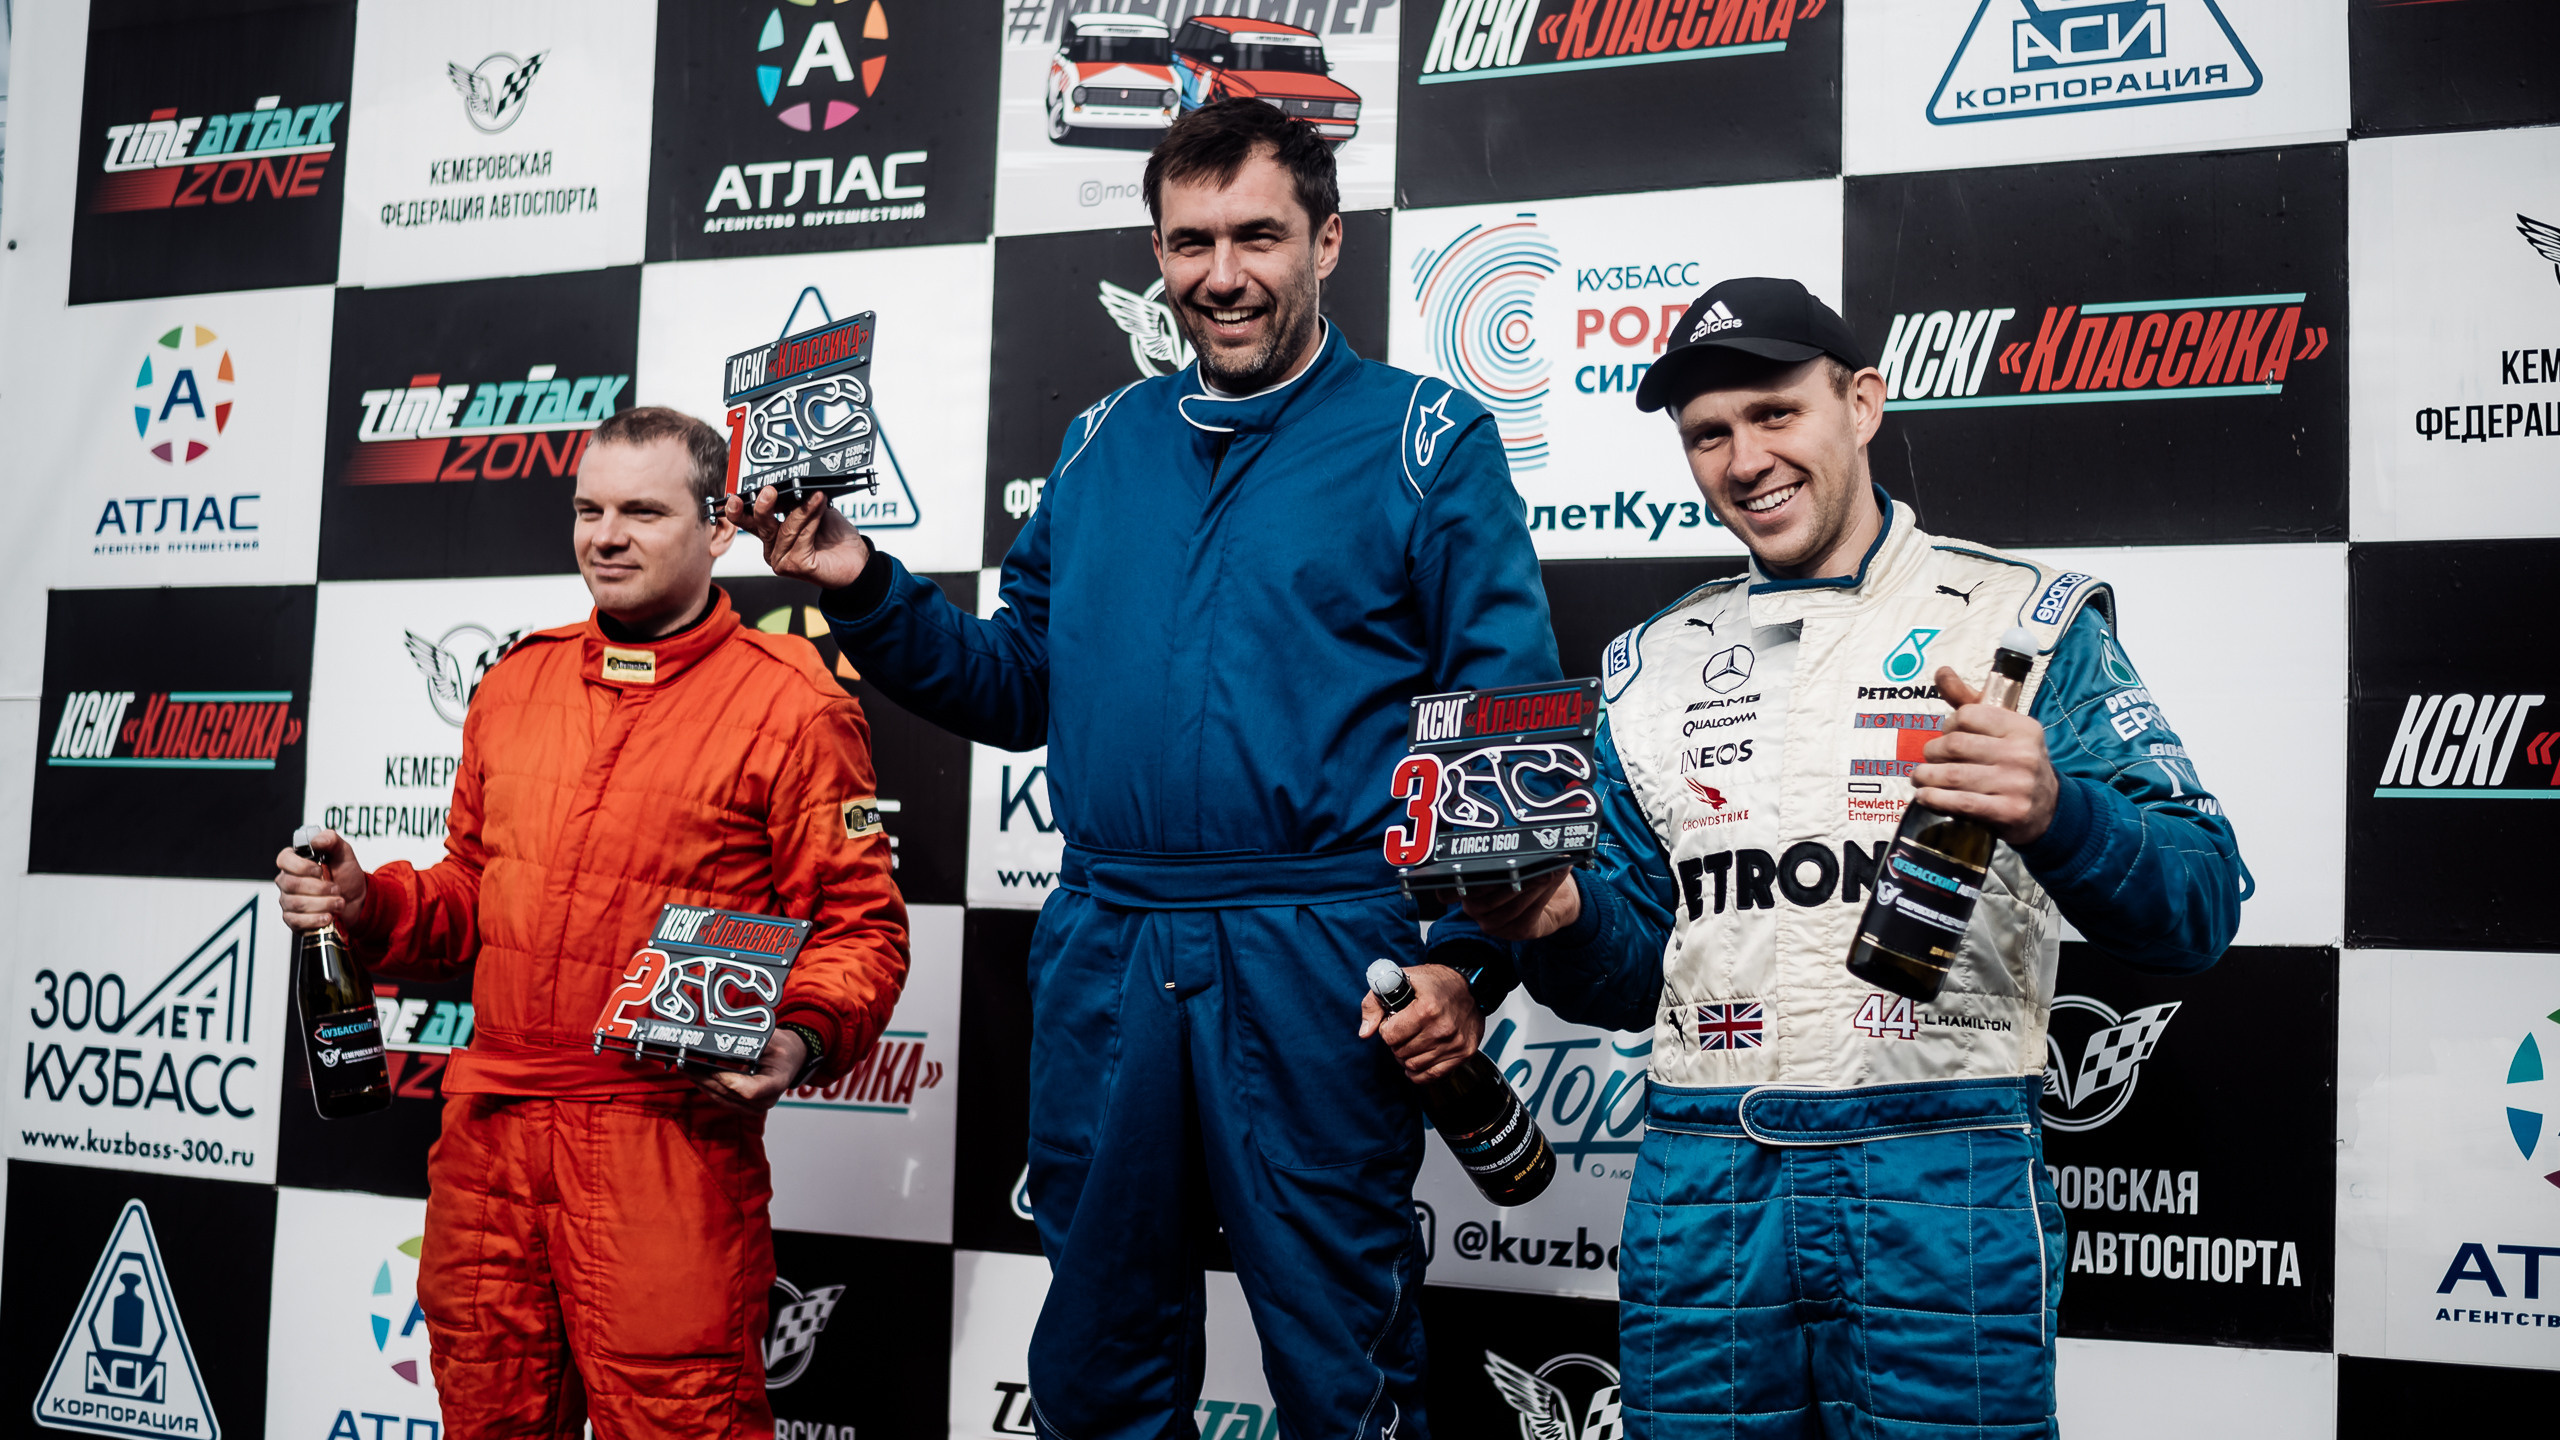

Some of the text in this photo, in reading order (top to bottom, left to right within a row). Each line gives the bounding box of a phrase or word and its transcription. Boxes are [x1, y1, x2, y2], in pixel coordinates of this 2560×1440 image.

[2016, 8, 2165, 69] АСИ
[1956, 62, 2230, 110] КОРПОРАЦИЯ
[103, 95, 345, 174] TIME ATTACK
[173, 151, 332, 208] ZONE
[429, 150, 553, 187] КЕМЕРОВСКАЯ
[704, 150, 928, 213] АТЛАС
[380, 186, 600, 230] ФЕДЕРАЦИЯ АВТОСПОРТА
[703, 202, 927, 234] АГЕНТСТВО ПУТЕШЕСТВИЙ
[1576, 261, 1701, 293] КУЗБАСС
[1689, 317, 1743, 343] adidas
[729, 347, 773, 396] КСКГ
[1877, 307, 2016, 400] КСКГ
[358, 364, 630, 443] TIME ATTACK
[726, 402, 751, 498] 1
[844, 456, 863, 468] 2022
[95, 494, 262, 536] АТЛАС
[93, 538, 260, 556] АГЕНТСТВО ПУТЕШЕСТВИЙ
[1703, 693, 1761, 710] AMG
[1857, 685, 1944, 701] PETRONA
[50, 690, 135, 759] КСКГ
[1415, 697, 1469, 742] КСКГ
[1859, 713, 1941, 730] TOMMY
[2379, 693, 2547, 787] КСКГ
[1680, 739, 1754, 775] INEOS
[1854, 761, 1915, 778] HILFIG
[1383, 753, 1443, 866] 3
[1682, 809, 1750, 832] CROWDSTRIKE
[1847, 797, 1895, 811] Hewlett
[1848, 810, 1901, 825] Enterpris
[1450, 832, 1520, 856] КЛАСС 1600
[1562, 836, 1586, 849] 2022
[658, 906, 709, 943] КСКГ
[31, 968, 217, 1041] 300 ЛЕТ
[592, 947, 672, 1039] 2
[648, 1024, 705, 1047] КЛАСС 1600
[1853, 993, 1919, 1040] 44
[733, 1045, 753, 1056] 2022
[24, 1041, 258, 1118] КУЗБАСС
[1489, 1100, 1521, 1147] АВТОДРОМ
[20, 1127, 256, 1168] www.kuzbass-300.ru
[1513, 1169, 1527, 1182] ДЛЯ
[2070, 1230, 2302, 1288] АВТОСПОРТА
[86, 1355, 166, 1402] АСИ
[52, 1396, 199, 1433] КОРПОРАЦИЯ
